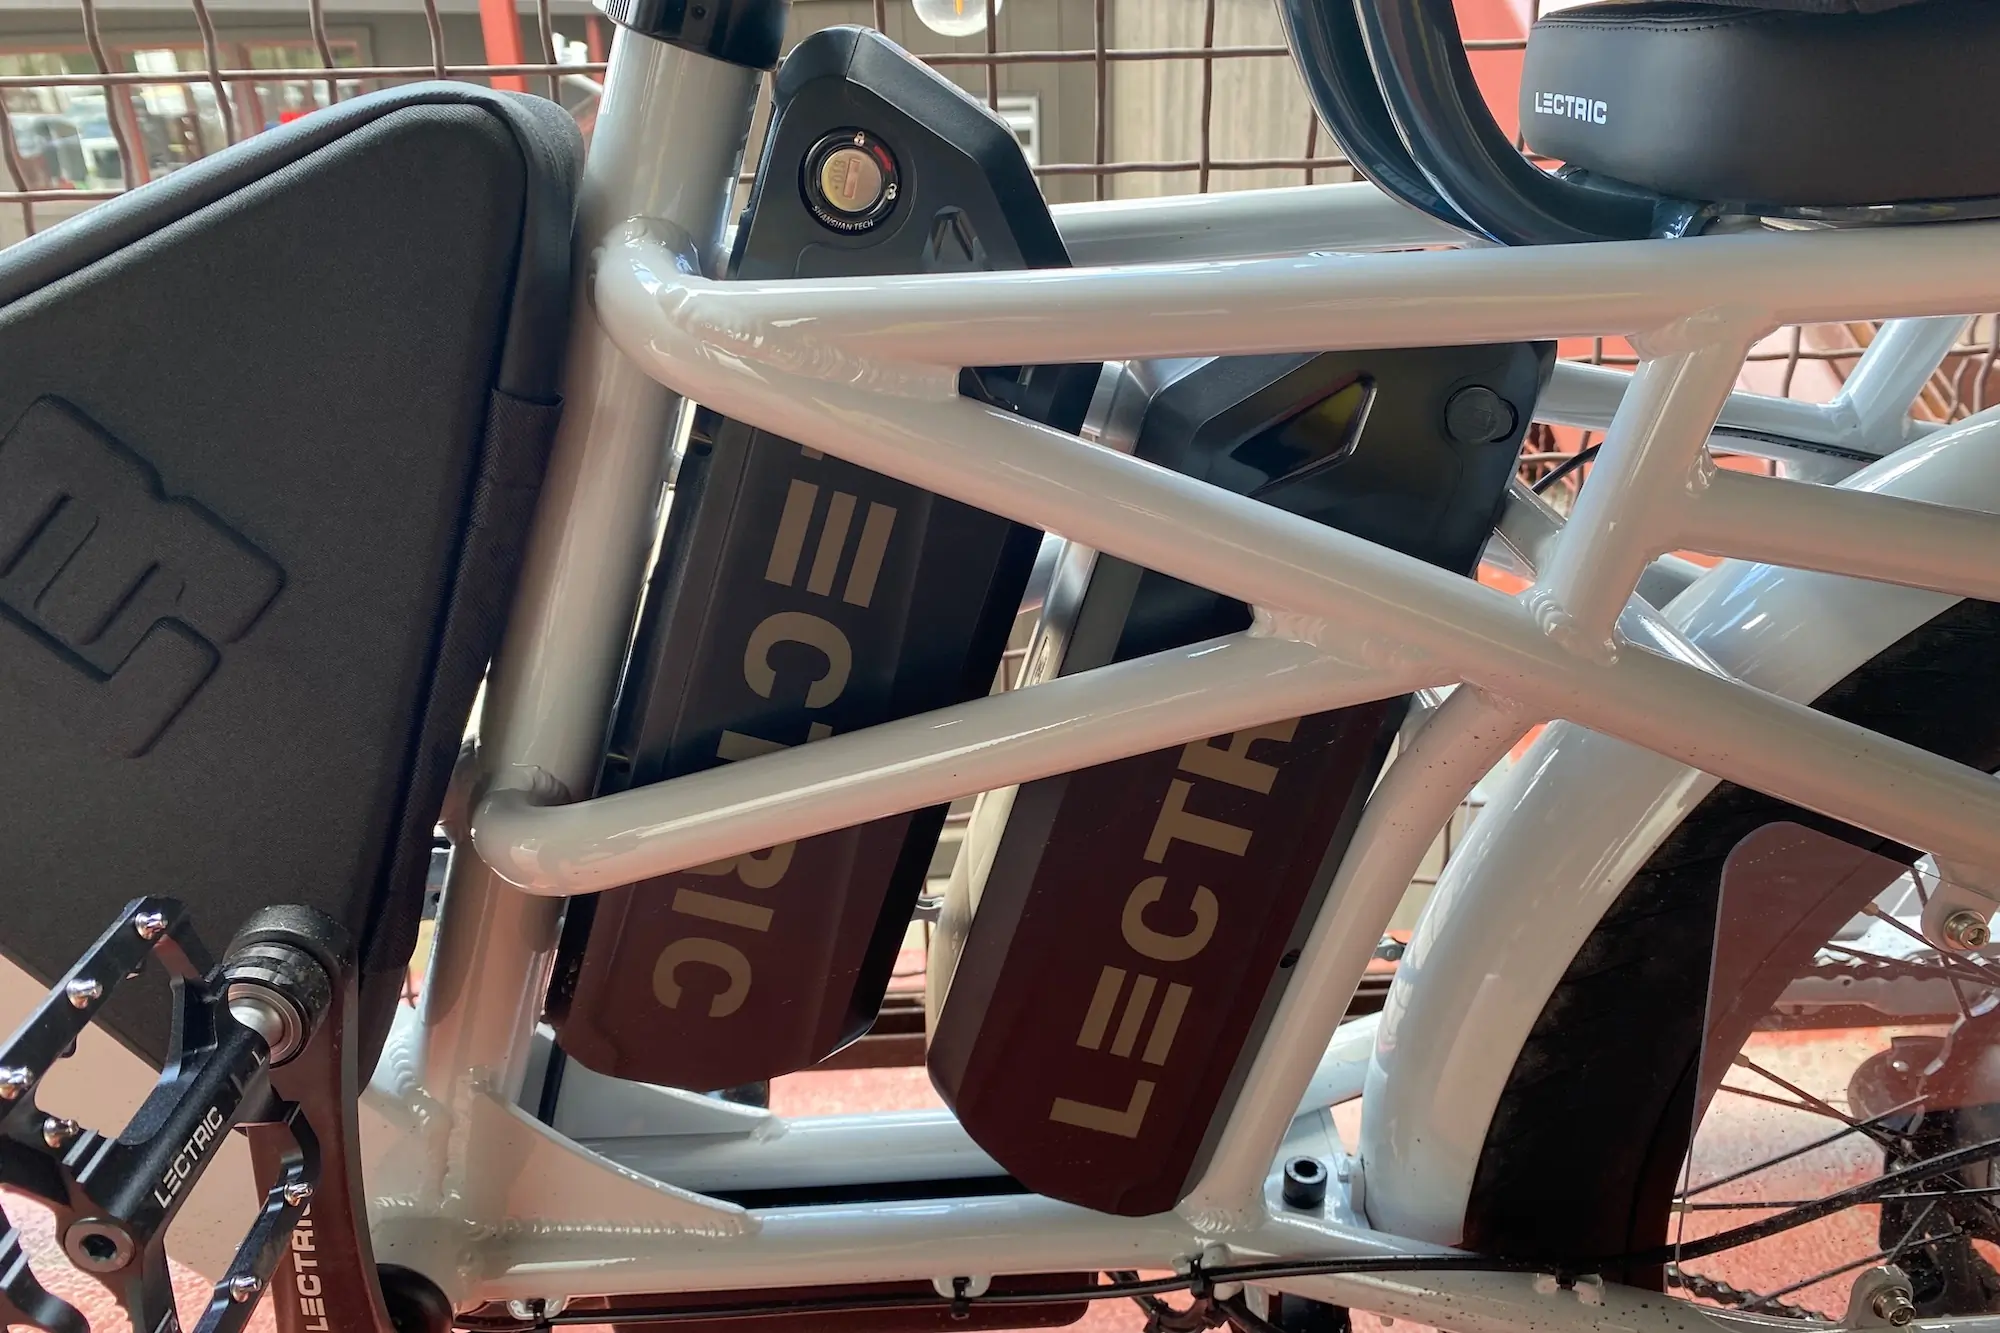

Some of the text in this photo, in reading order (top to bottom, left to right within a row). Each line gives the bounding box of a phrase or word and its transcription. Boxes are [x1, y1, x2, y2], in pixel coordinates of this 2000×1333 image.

[1535, 91, 1608, 125] LECTRIC
[812, 204, 874, 231] SHANSHAN TECH
[153, 1105, 224, 1209] LECTRIC
[291, 1203, 329, 1331] LECTRI
